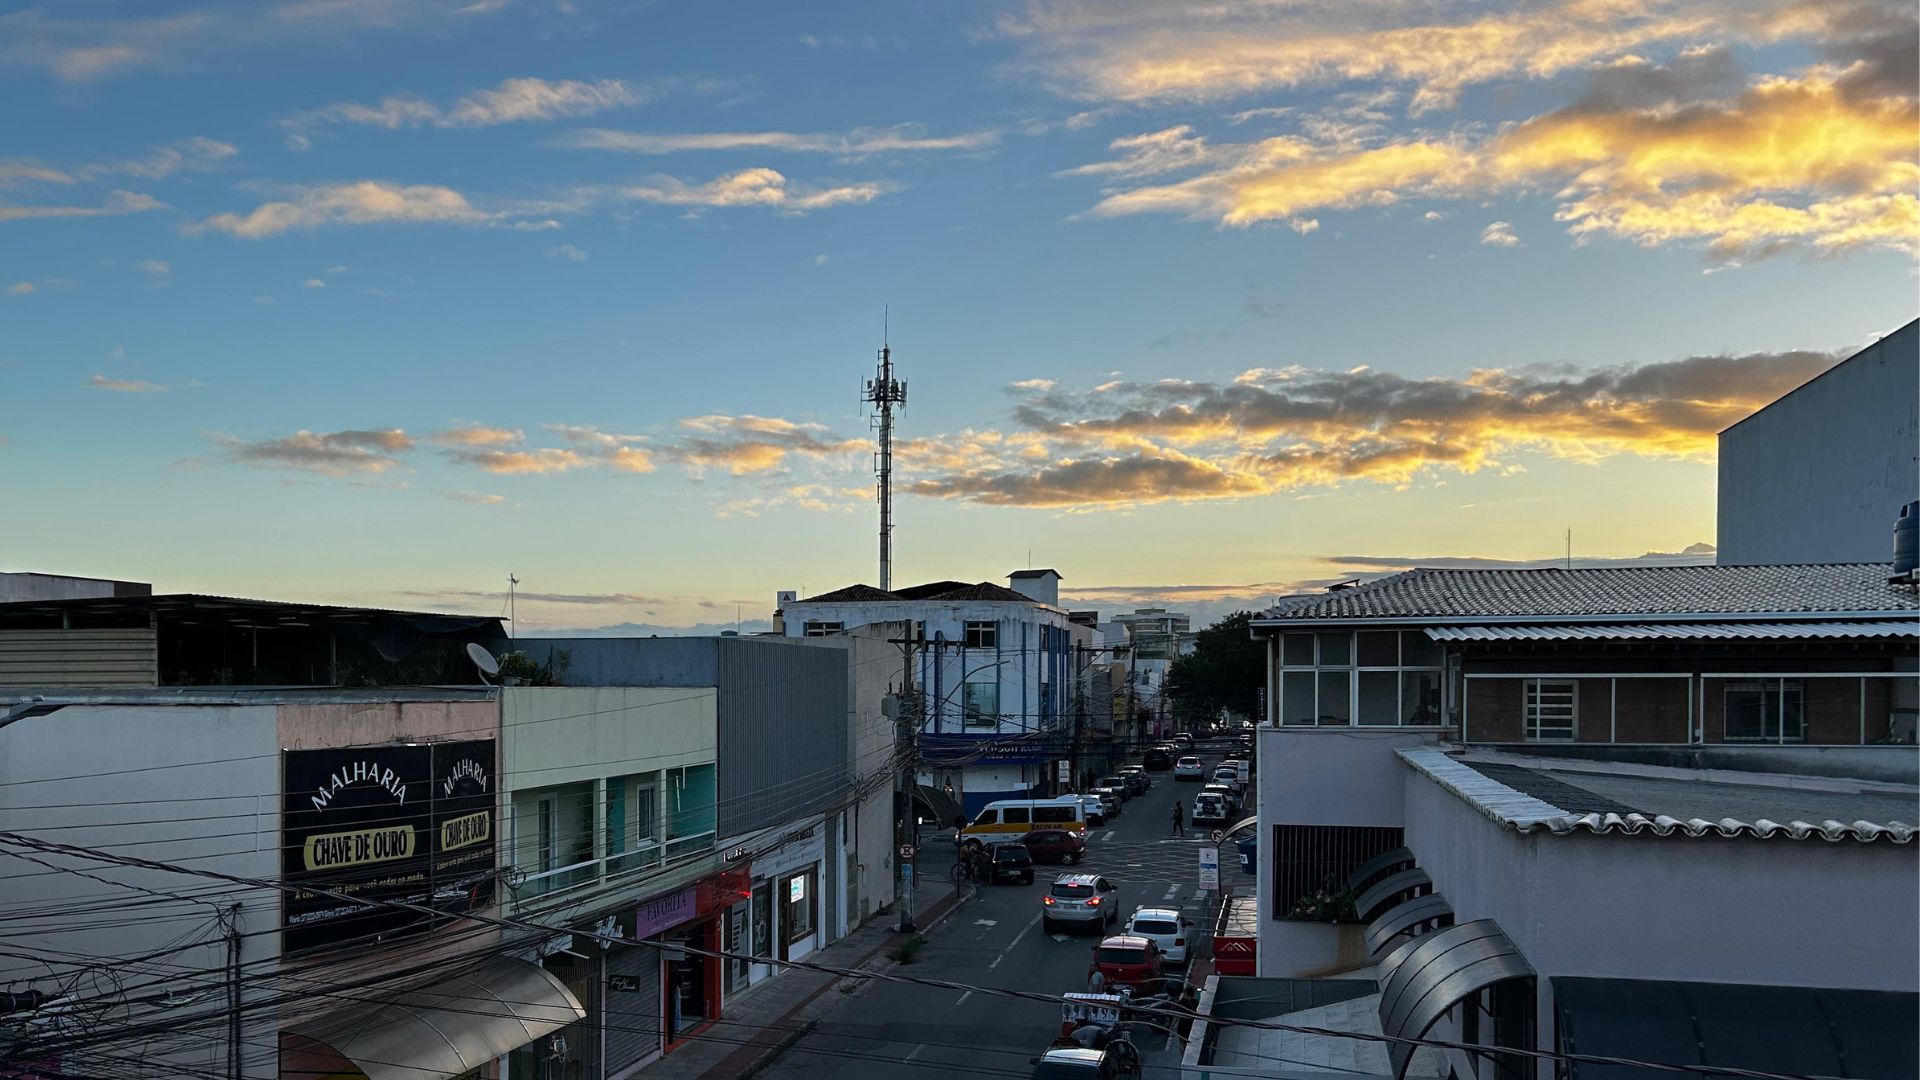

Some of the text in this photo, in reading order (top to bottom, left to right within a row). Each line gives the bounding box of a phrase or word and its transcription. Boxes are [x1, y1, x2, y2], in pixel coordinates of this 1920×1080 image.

[311, 761, 407, 813] MALHARIA
[443, 758, 487, 799] MALHARIA
[313, 836, 352, 866] CHAVE
[355, 834, 371, 861] DE
[374, 830, 408, 859] OURO
[446, 814, 486, 848] CHAVE DE OURO
[647, 892, 686, 920] FAVORITA
